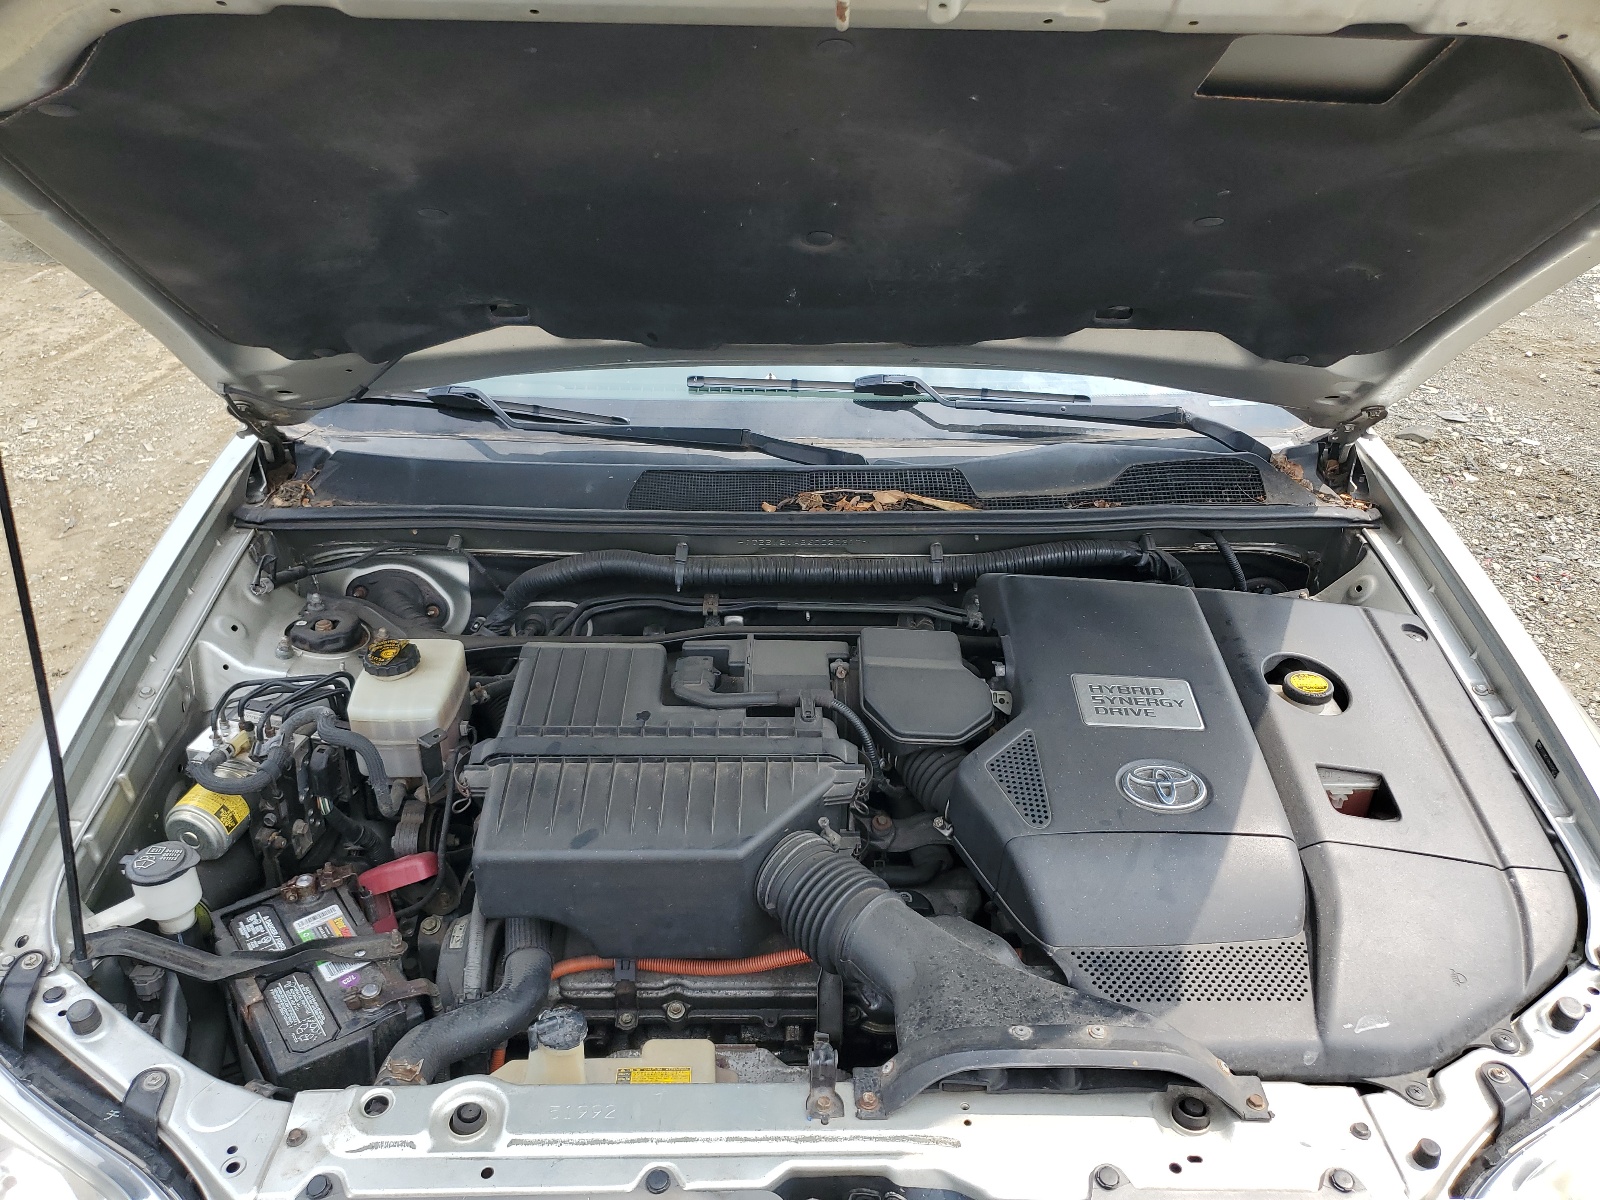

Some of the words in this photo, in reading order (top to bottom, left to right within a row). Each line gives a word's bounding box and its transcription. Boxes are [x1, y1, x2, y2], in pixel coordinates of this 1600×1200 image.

[1088, 684, 1164, 696] HYBRID
[1091, 695, 1185, 708] SYNERGY
[1094, 706, 1157, 718] DRIVE
